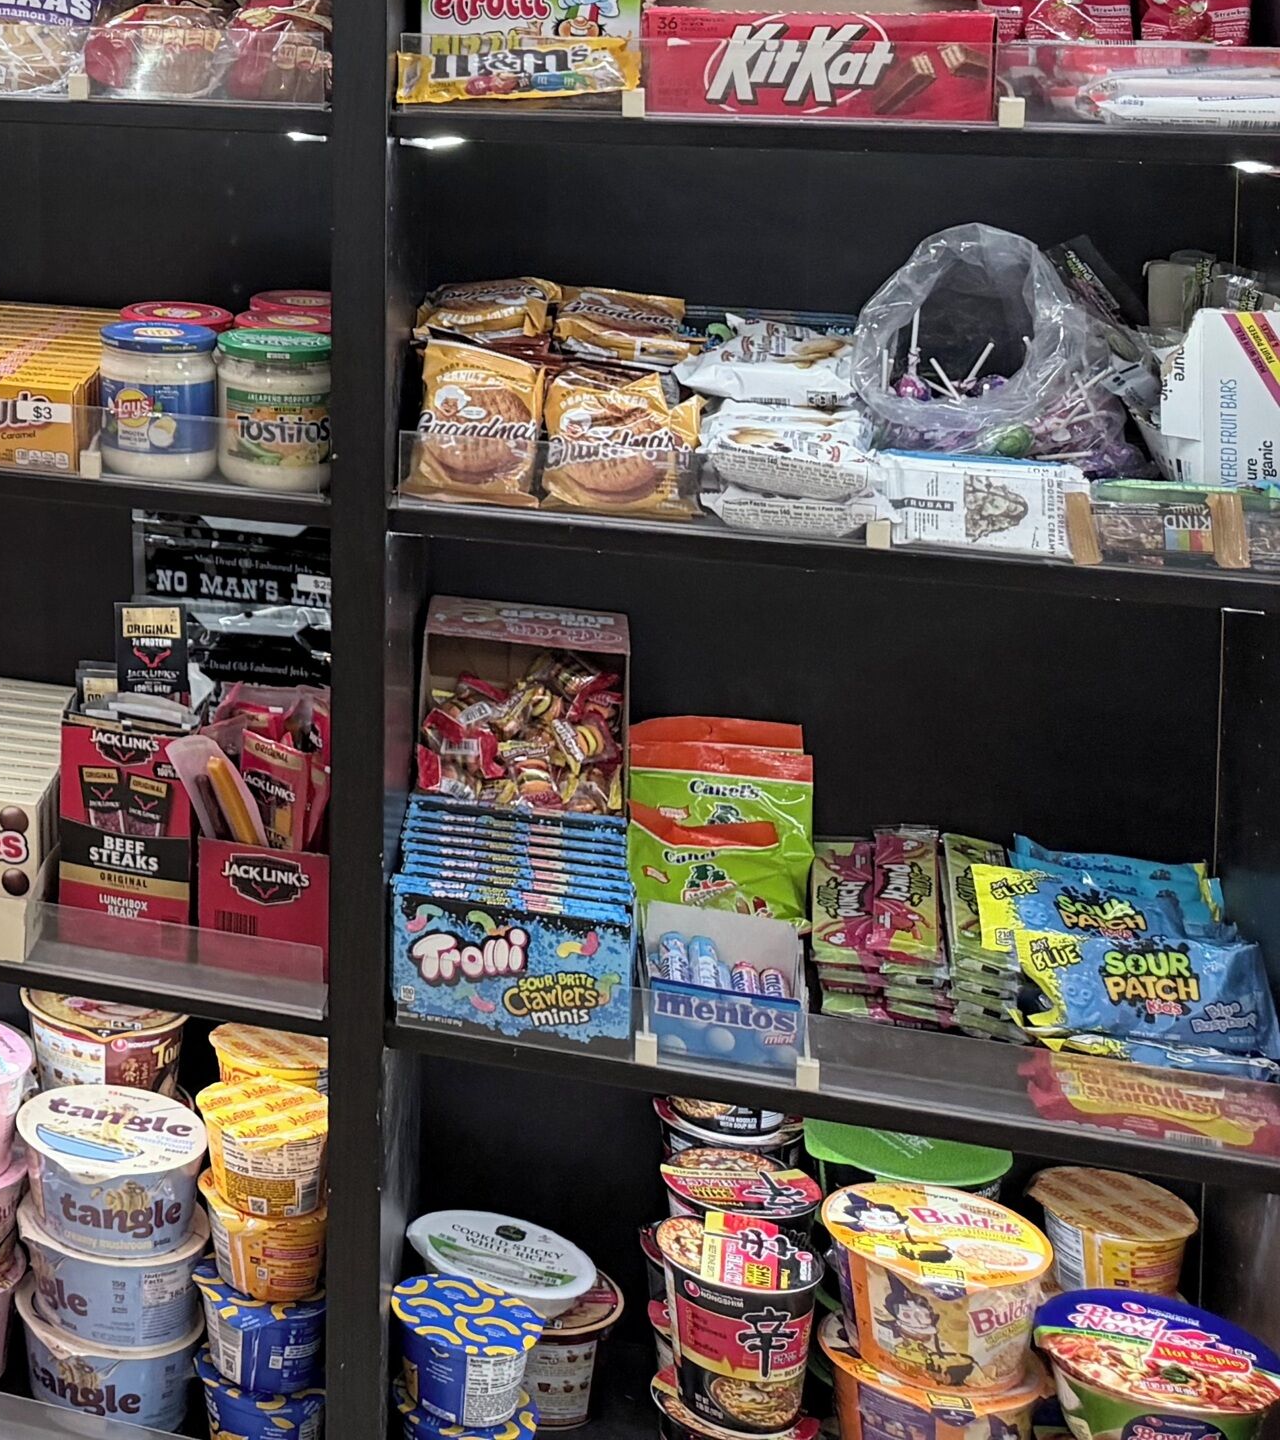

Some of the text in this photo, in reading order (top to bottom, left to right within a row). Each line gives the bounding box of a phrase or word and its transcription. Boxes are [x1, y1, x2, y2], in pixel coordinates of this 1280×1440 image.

[49, 13, 73, 27] Roll
[705, 23, 895, 105] KitKat
[32, 407, 52, 420] $3
[1220, 378, 1238, 448] FRUIT BARS
[1, 431, 36, 440] Caramel
[237, 414, 330, 444] Tostitos
[902, 498, 954, 511] TRUBAR
[1164, 515, 1211, 530] KIND
[154, 569, 278, 601] NO MAN'S
[126, 623, 177, 636] ORIGINAL
[140, 638, 171, 648] PROTEIN
[90, 729, 160, 753] JACK LINK'S
[102, 834, 145, 855] BEEF
[89, 845, 159, 872] STEAKS
[99, 871, 148, 889] ORIGINAL
[221, 861, 311, 888] JACK LINK'S
[839, 878, 865, 917] PUNCH
[992, 878, 1039, 900] BLUE
[98, 893, 149, 912] LUNCHBOX
[107, 904, 140, 918] READY
[412, 929, 528, 982] Trolli
[1030, 938, 1049, 952] JUST
[1030, 946, 1081, 971] BLUE
[1105, 951, 1191, 978] SOUR
[518, 972, 595, 991] SOUR BRITE
[1105, 974, 1200, 1002] PATCH
[503, 985, 599, 1015] Crawlers
[1145, 999, 1182, 1015] Kids
[530, 1009, 590, 1027] minis
[654, 996, 798, 1032] mentos
[763, 1032, 797, 1046] mint
[47, 1096, 194, 1138] tangle
[59, 1192, 182, 1239] tangle
[908, 1205, 1025, 1238] Buldak
[451, 1223, 565, 1262] COOKED STICKY
[463, 1235, 544, 1264] WHITE RICE
[700, 1289, 744, 1308] NONGSHIM
[736, 1306, 798, 1379] 辛
[1158, 1345, 1247, 1370] Hot Spicy
